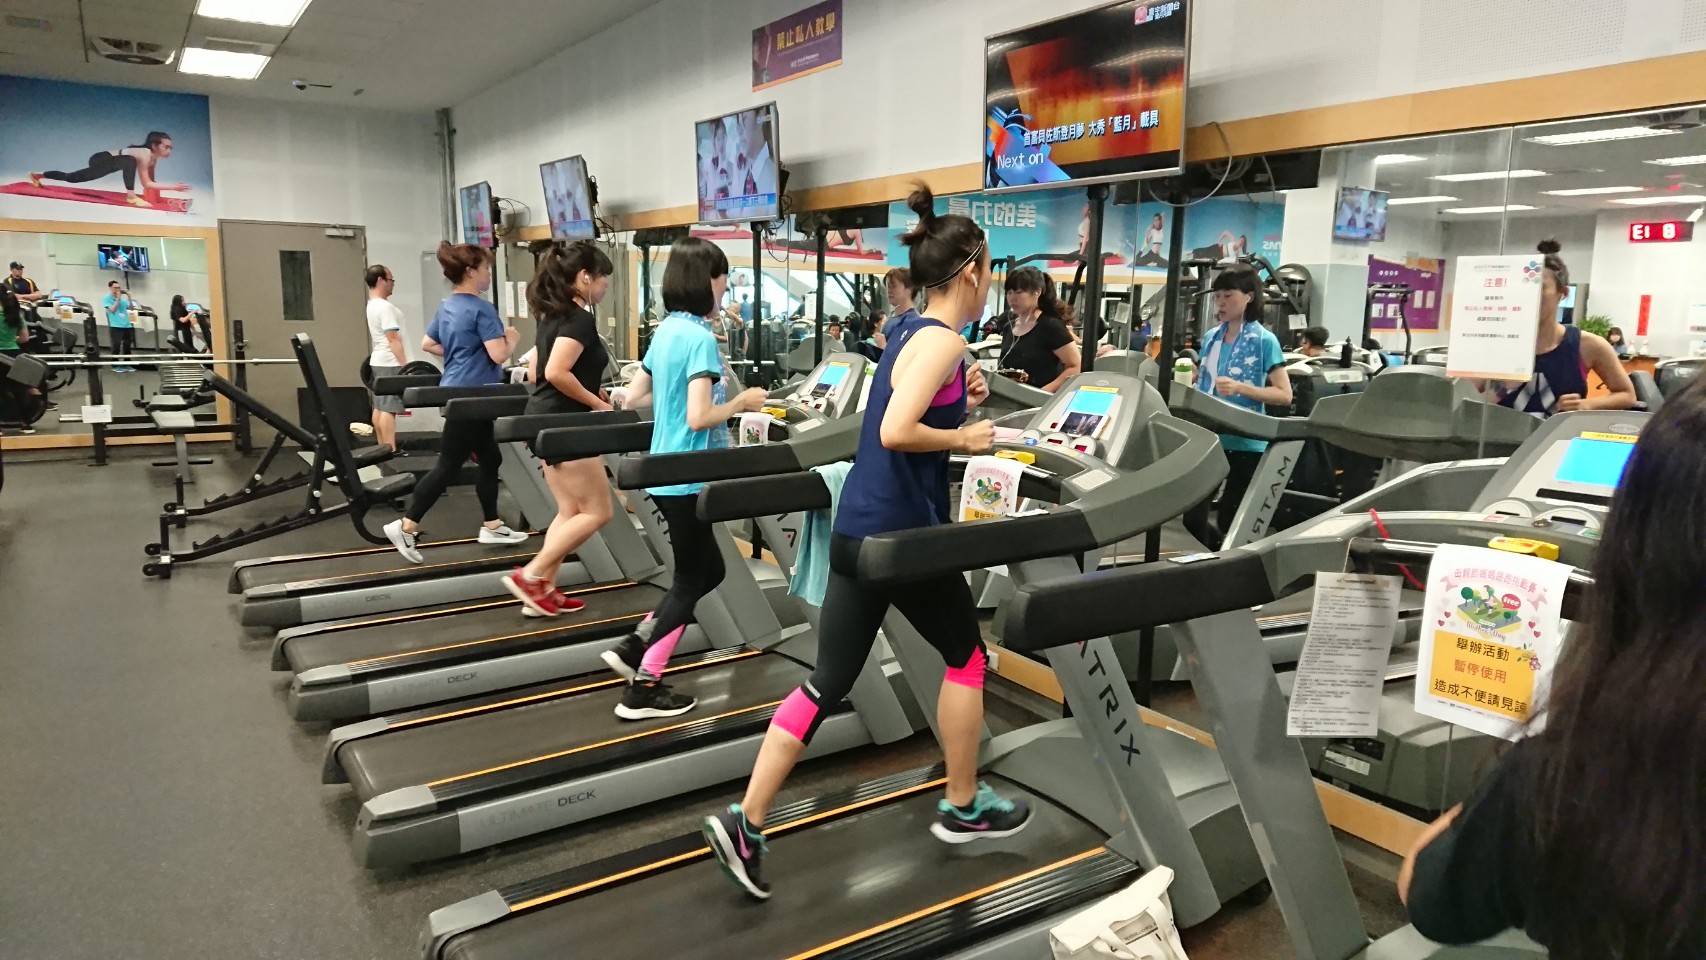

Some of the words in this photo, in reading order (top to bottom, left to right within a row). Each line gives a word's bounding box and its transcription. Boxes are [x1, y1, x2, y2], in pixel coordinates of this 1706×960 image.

[776, 11, 835, 51] 禁止私人教學
[1023, 122, 1085, 147] 首富貝佐斯登月夢
[997, 153, 1024, 169] Next
[1029, 152, 1044, 165] on
[1503, 595, 1520, 607] Free
[1456, 637, 1510, 662] 舉辦活動
[447, 672, 479, 684] DECK
[1454, 659, 1507, 684] 暫停使用
[1434, 678, 1528, 714] 造成不便請見諒
[557, 790, 596, 807] DECK
